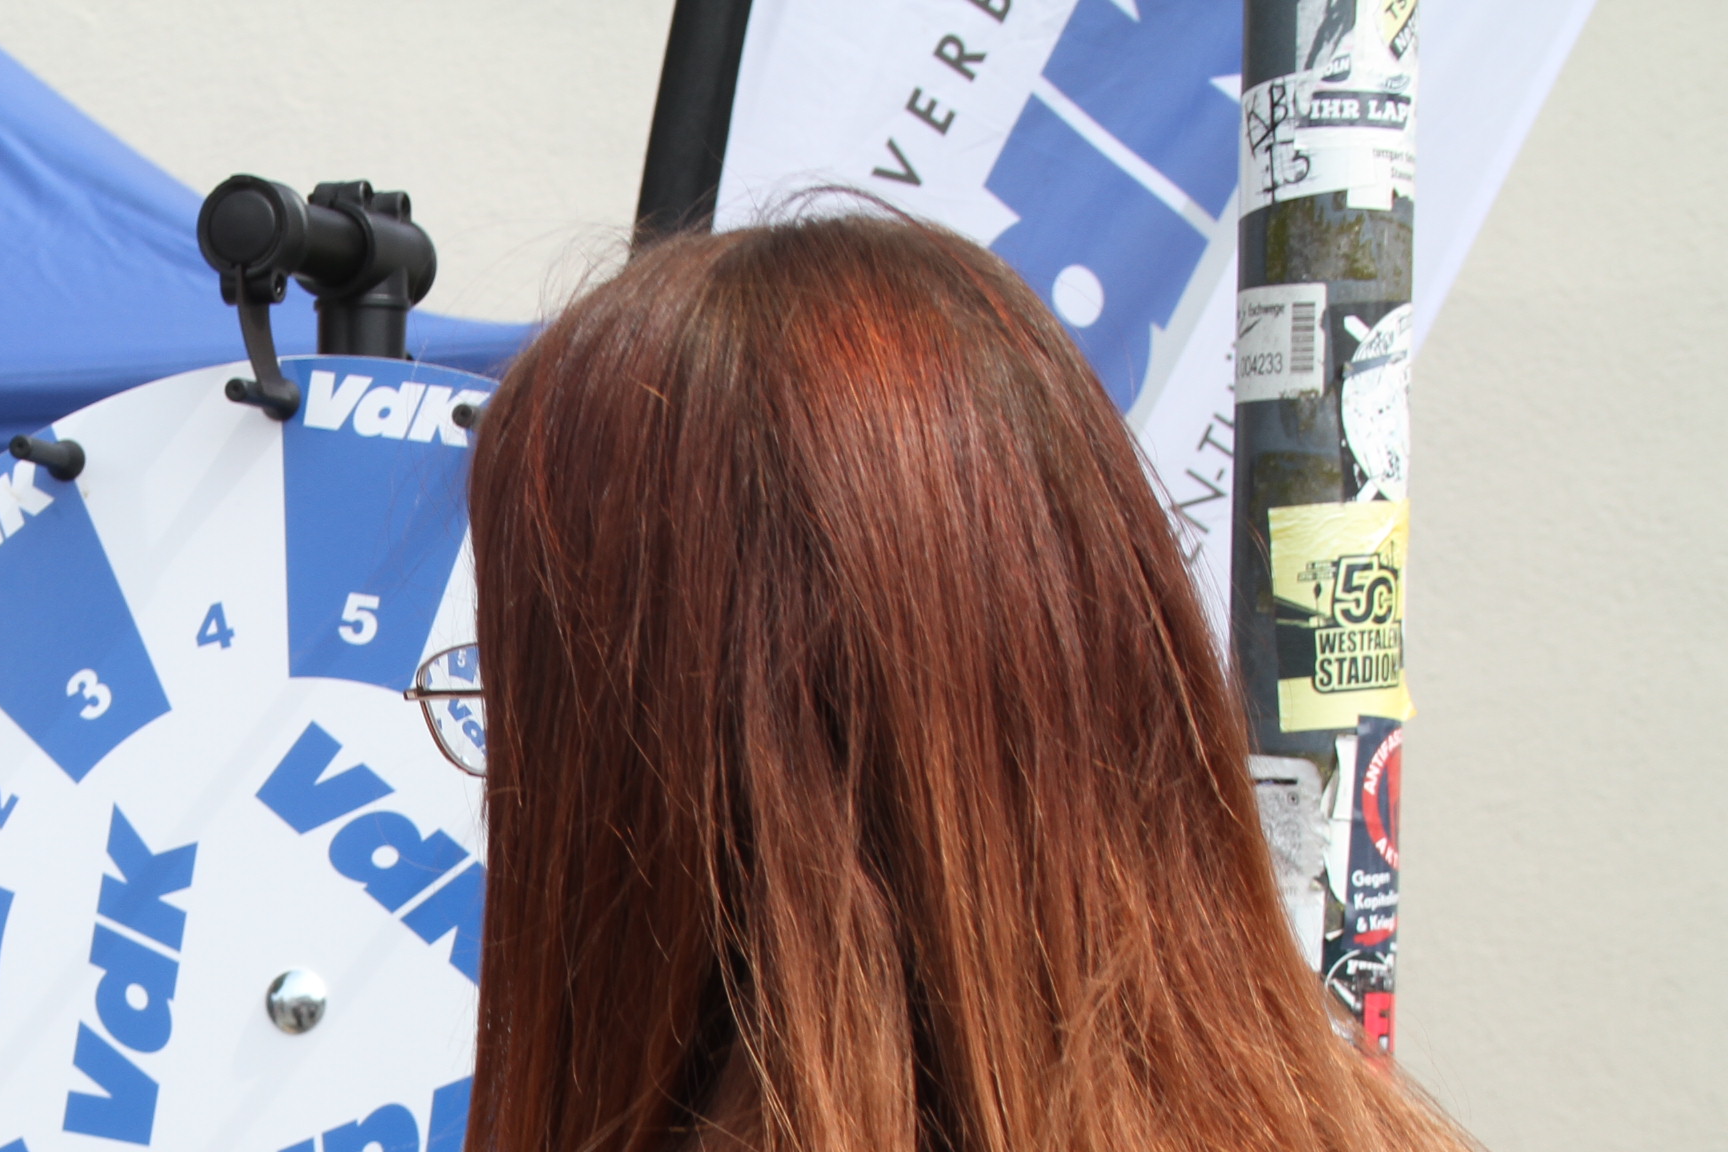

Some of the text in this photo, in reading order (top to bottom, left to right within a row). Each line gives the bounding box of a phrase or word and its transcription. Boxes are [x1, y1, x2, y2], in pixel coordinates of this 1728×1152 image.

[1310, 99, 1360, 119] IHR
[302, 370, 491, 447] VdK
[195, 602, 235, 651] 4
[337, 592, 380, 646] 5
[66, 668, 113, 720] 3
[1318, 653, 1399, 687] STADION
[255, 720, 486, 986] VdK
[62, 802, 199, 1147] VdK
